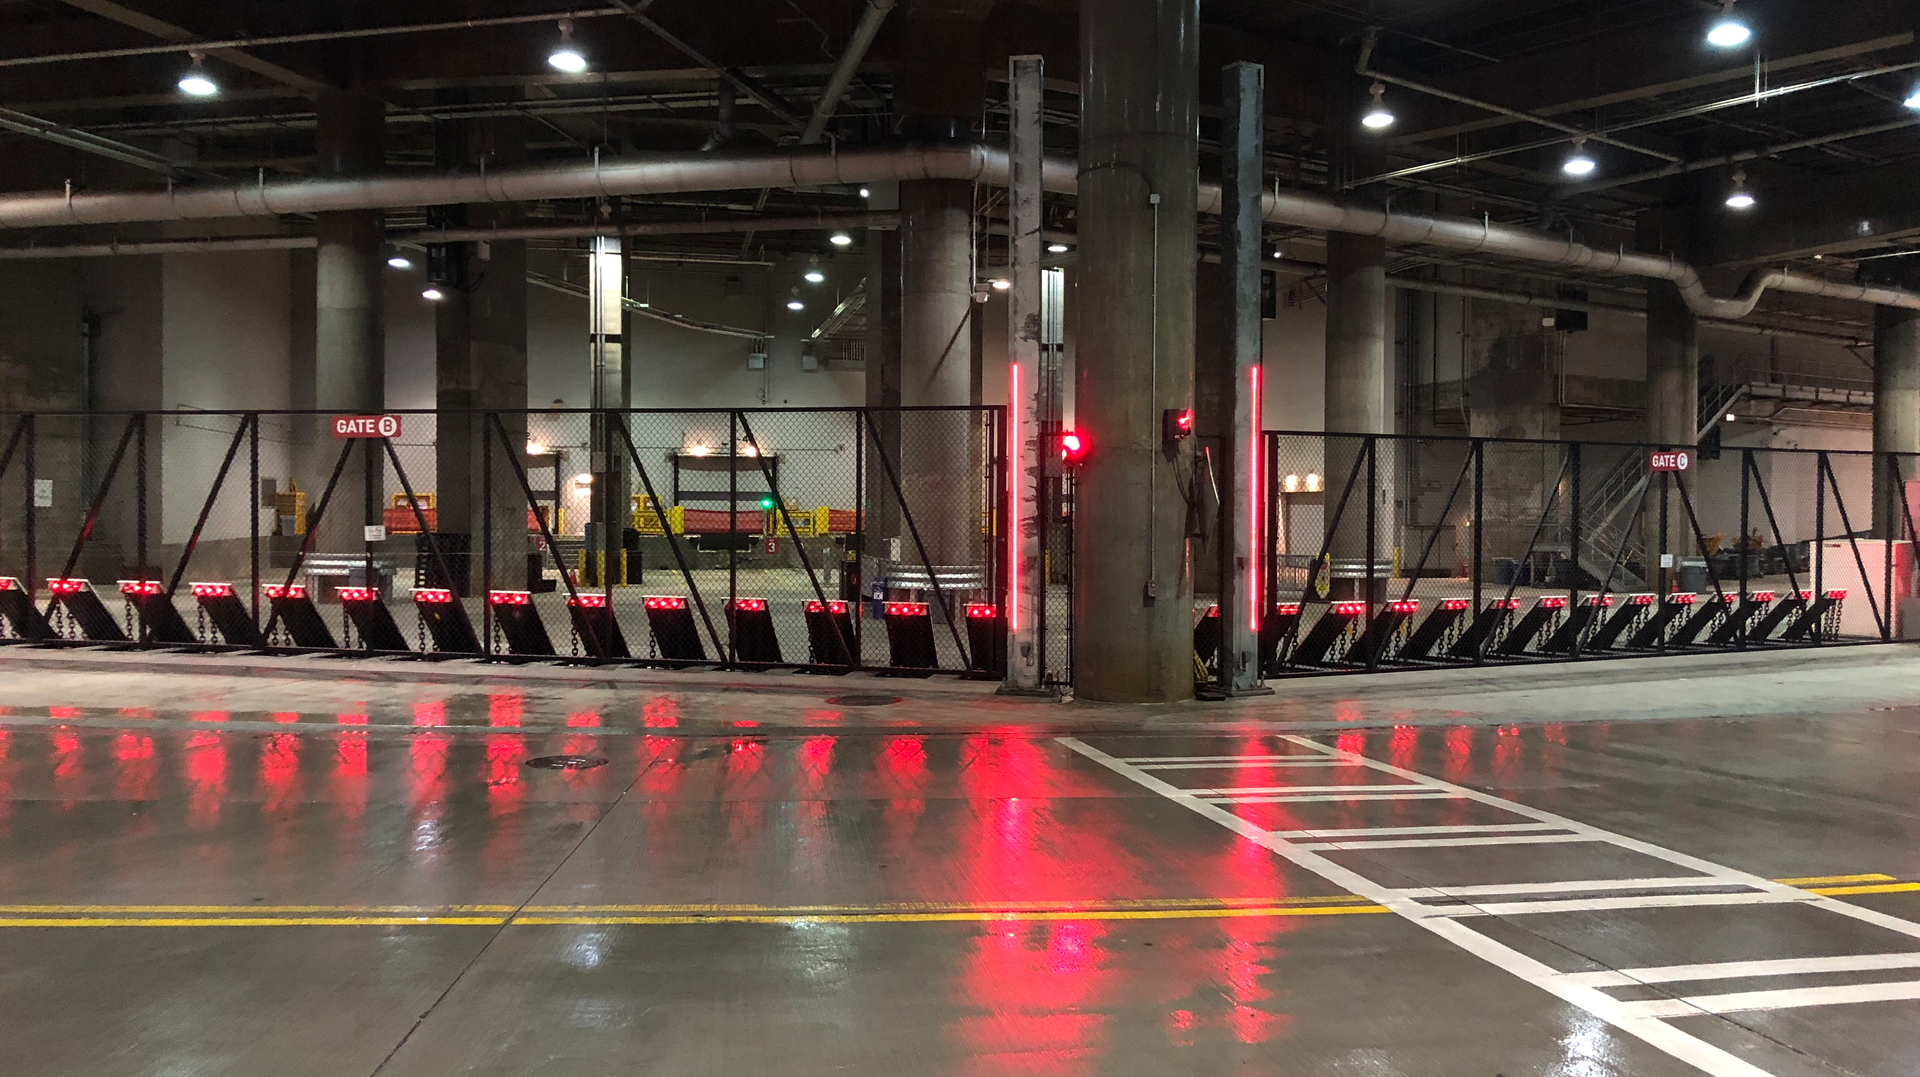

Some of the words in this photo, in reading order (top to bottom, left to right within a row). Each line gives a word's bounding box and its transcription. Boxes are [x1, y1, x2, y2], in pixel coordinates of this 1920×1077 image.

[336, 419, 376, 434] GATE
[383, 419, 393, 433] B
[1652, 454, 1676, 467] GATE
[539, 540, 547, 551] 2
[768, 542, 776, 553] 3
